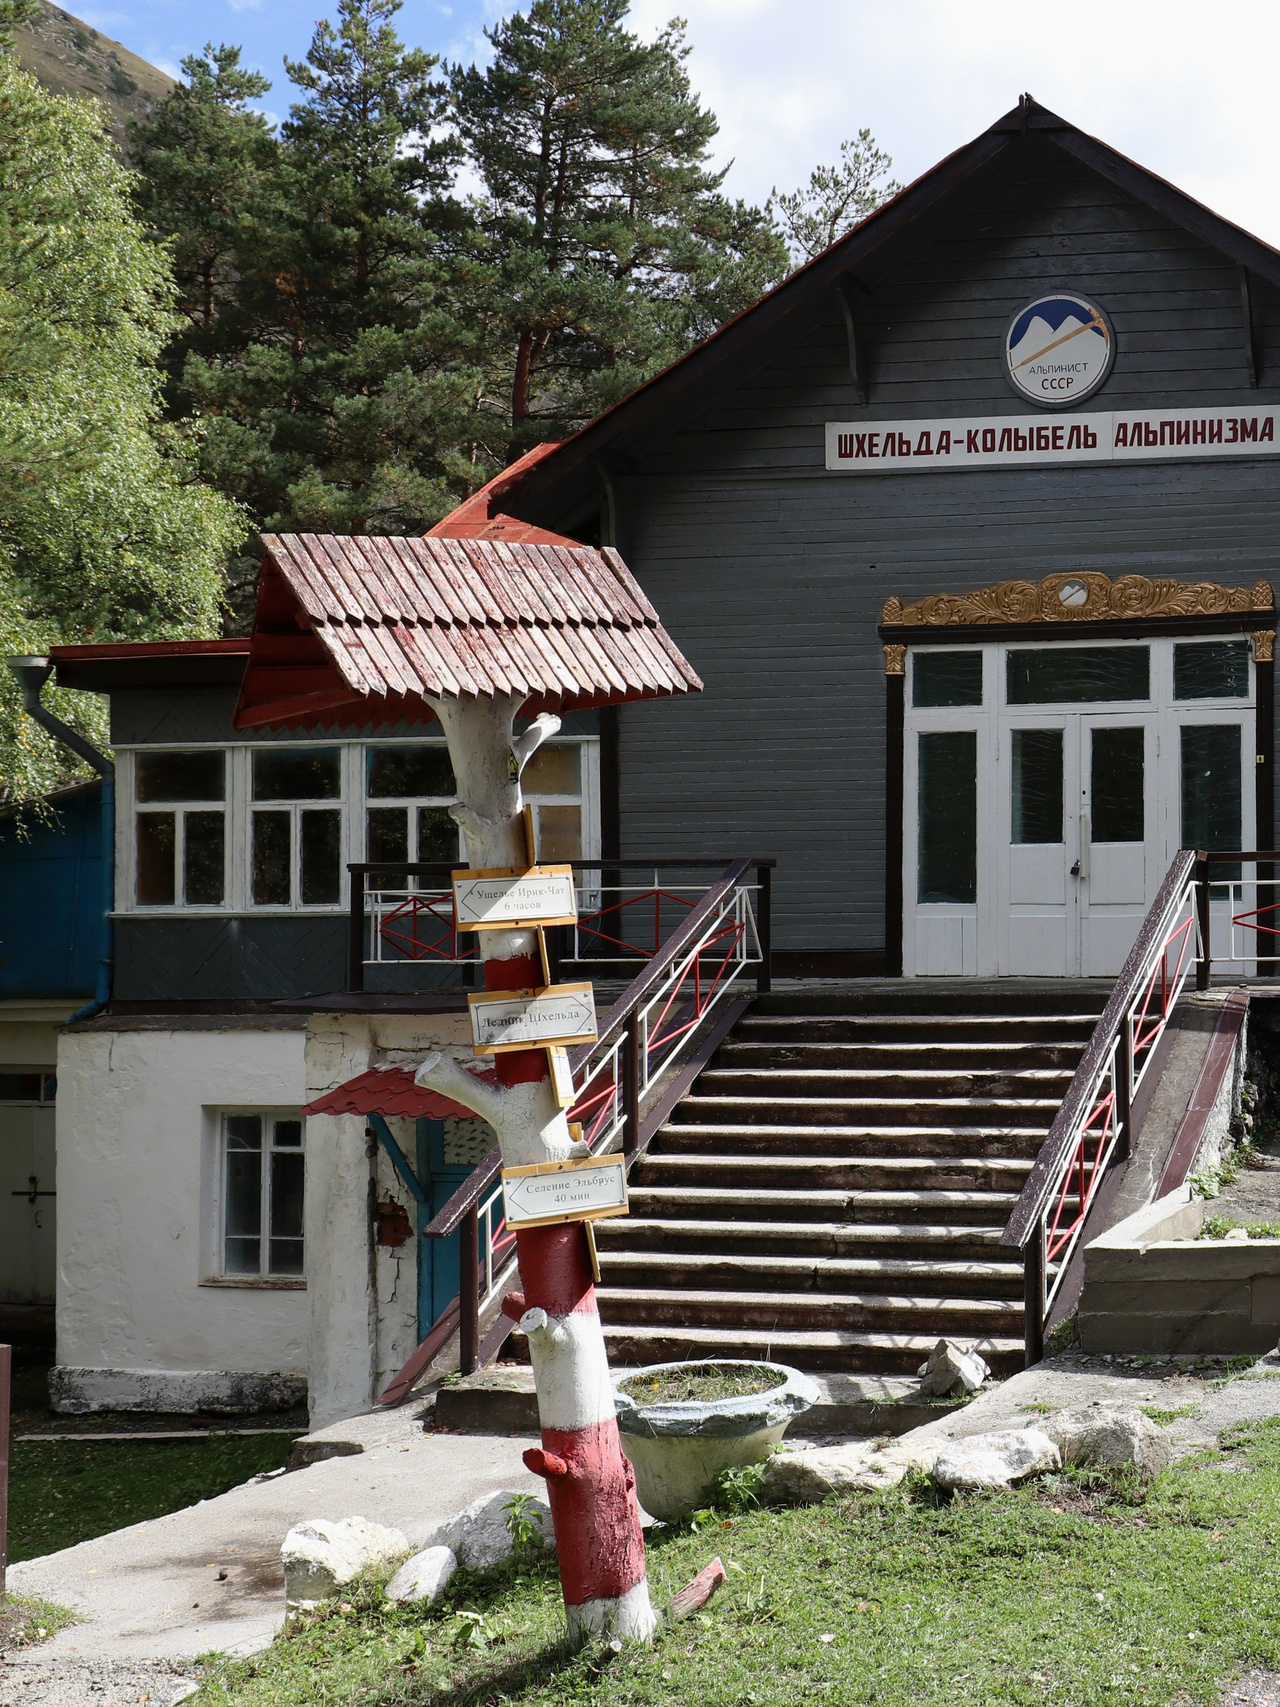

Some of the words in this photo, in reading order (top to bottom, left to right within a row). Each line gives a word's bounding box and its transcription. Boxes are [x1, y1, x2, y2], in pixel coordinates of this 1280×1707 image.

[1028, 363, 1088, 375] АЛЬПИНИСТ
[1041, 377, 1074, 390] СССР
[837, 425, 1098, 458] ШХЕЛЬДА-КОЛЫБЕЛЬ
[1114, 417, 1275, 447] АЛЬПИНИЗМА
[477, 889, 515, 899] Ущелье
[518, 886, 565, 897] Ирик-Чат
[504, 902, 510, 910] 6
[513, 902, 541, 910] часов
[482, 1017, 525, 1028] Ледник
[529, 1011, 580, 1023] Шхельда
[526, 1181, 570, 1194] Селение
[573, 1175, 615, 1188] Эльбрус
[554, 1194, 567, 1203] 40
[570, 1192, 590, 1202] мин
